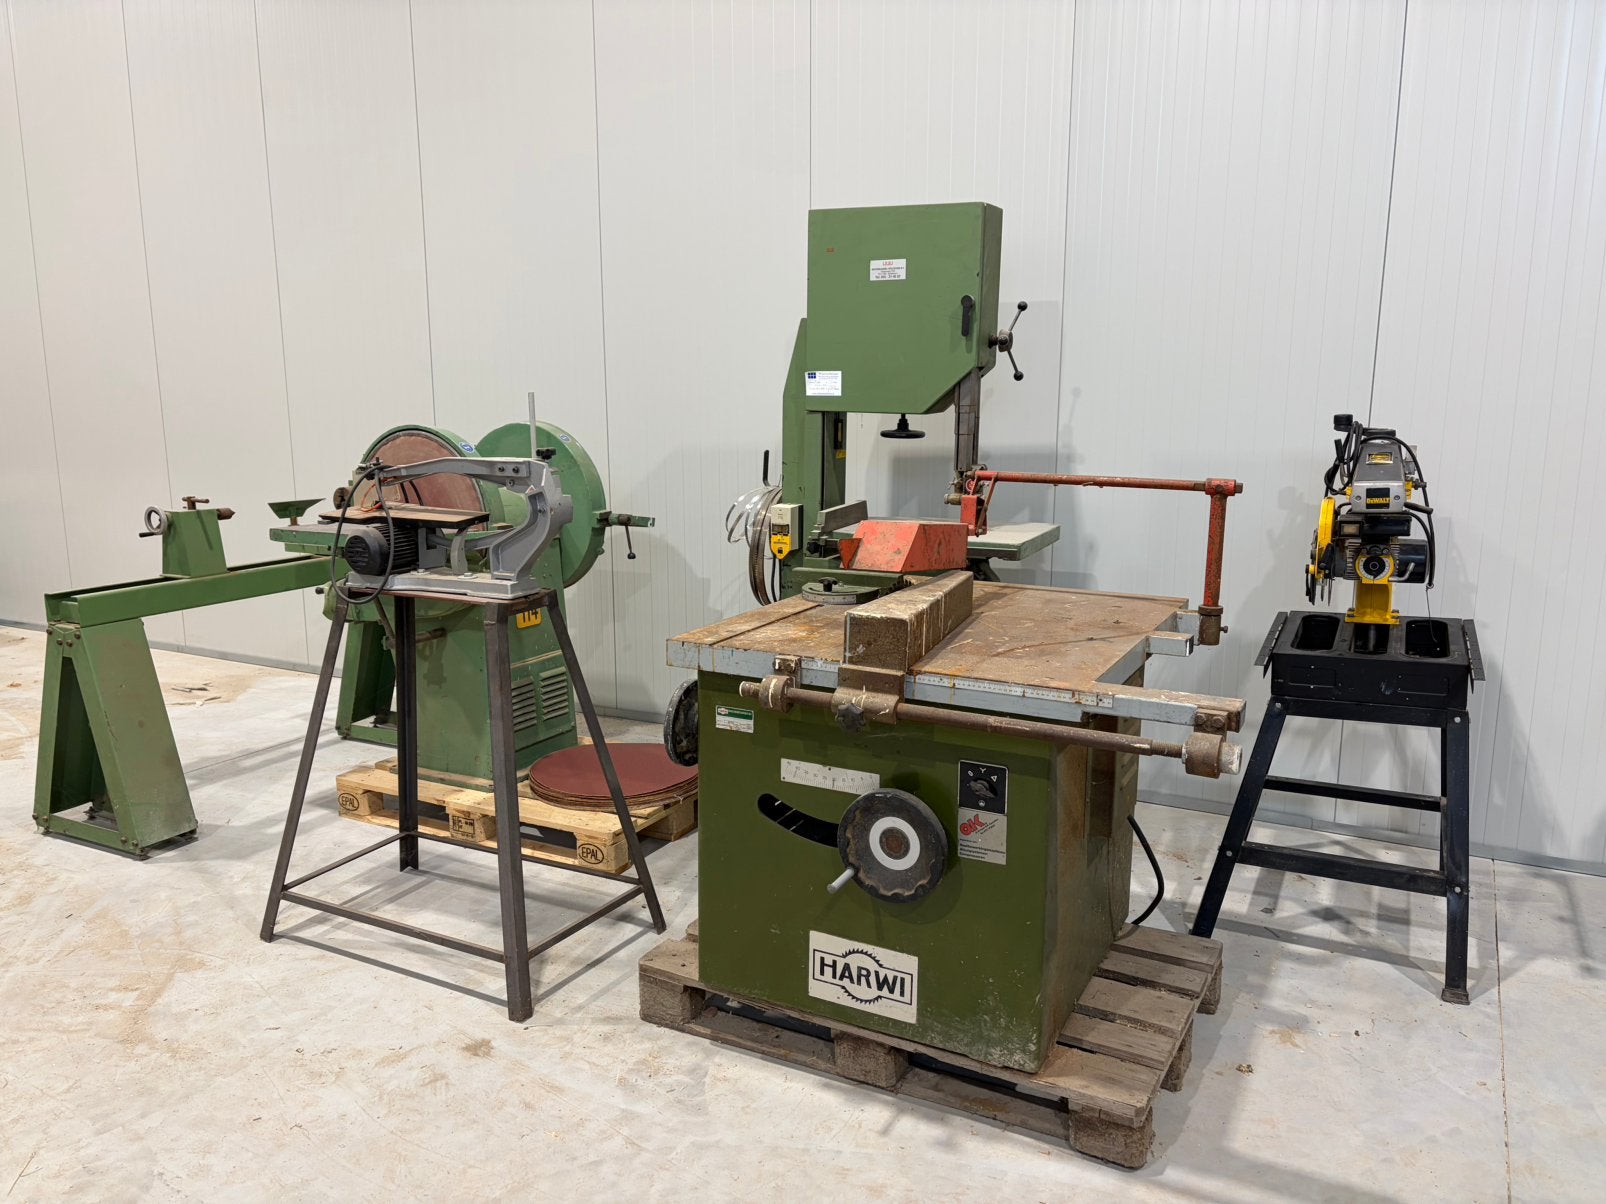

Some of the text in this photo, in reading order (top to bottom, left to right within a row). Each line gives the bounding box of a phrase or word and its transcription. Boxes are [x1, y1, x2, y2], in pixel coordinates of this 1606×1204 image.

[341, 795, 357, 809] EPAL
[581, 846, 600, 861] EPAL
[819, 956, 906, 998] HARWI
